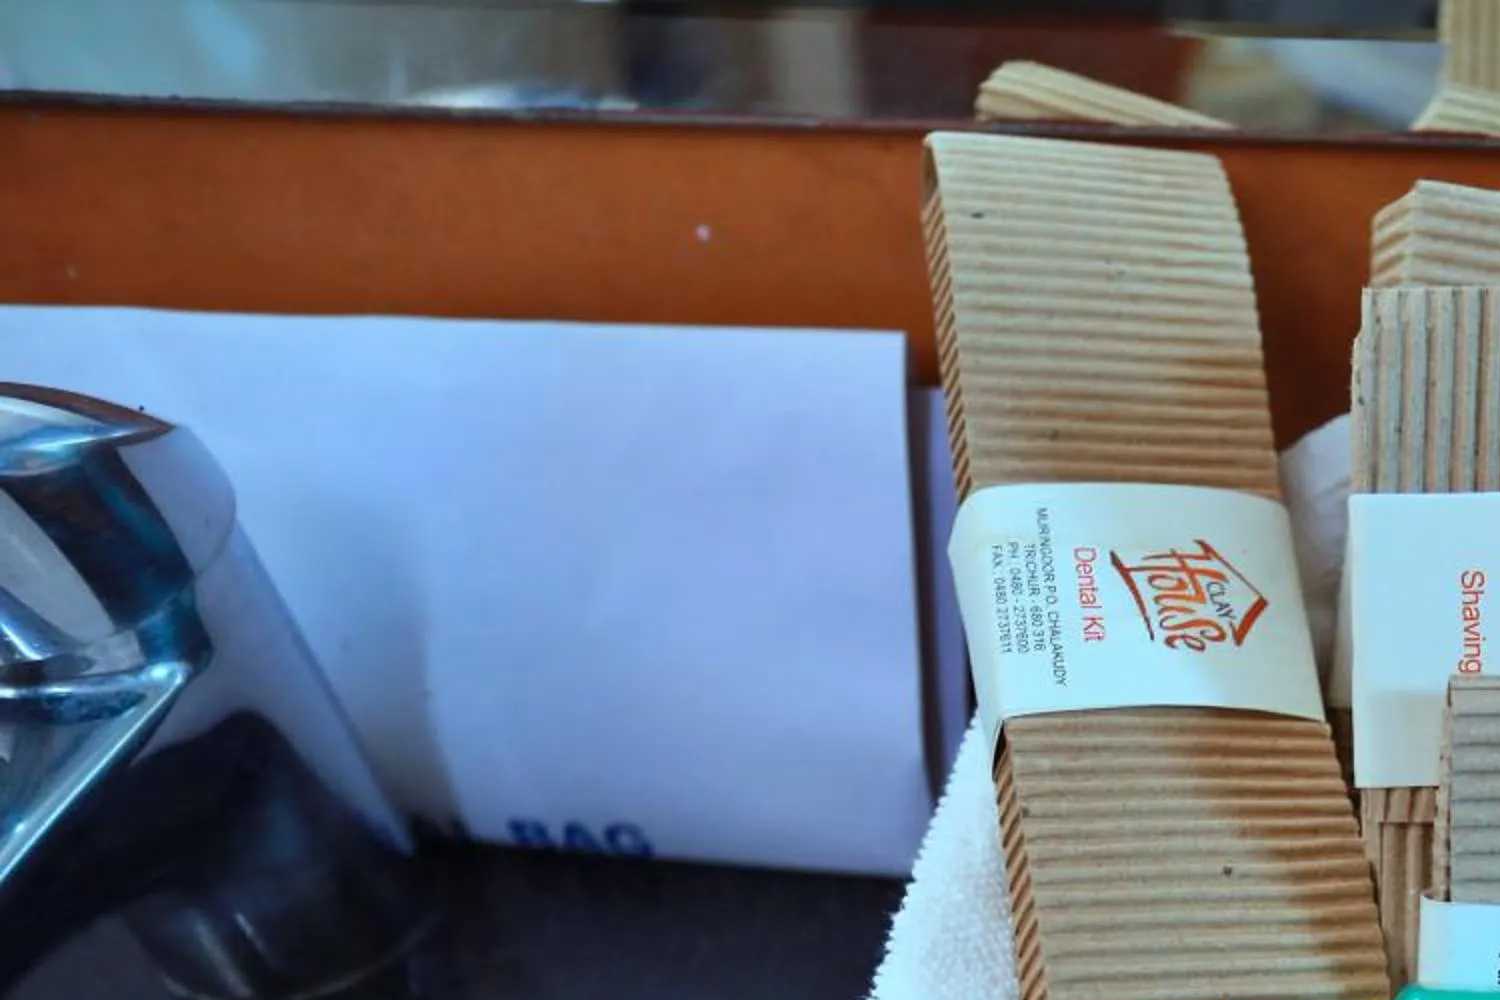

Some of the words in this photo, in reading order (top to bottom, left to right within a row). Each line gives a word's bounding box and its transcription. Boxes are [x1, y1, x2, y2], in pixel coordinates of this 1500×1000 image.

[1023, 543, 1040, 597] TRICHUR
[1073, 547, 1103, 610] Dental
[1125, 545, 1227, 652] House
[1206, 581, 1235, 617] CLAY
[1047, 611, 1068, 687] CHALAKUDY
[1083, 615, 1108, 643] Kit
[1458, 570, 1485, 674] Shaving
